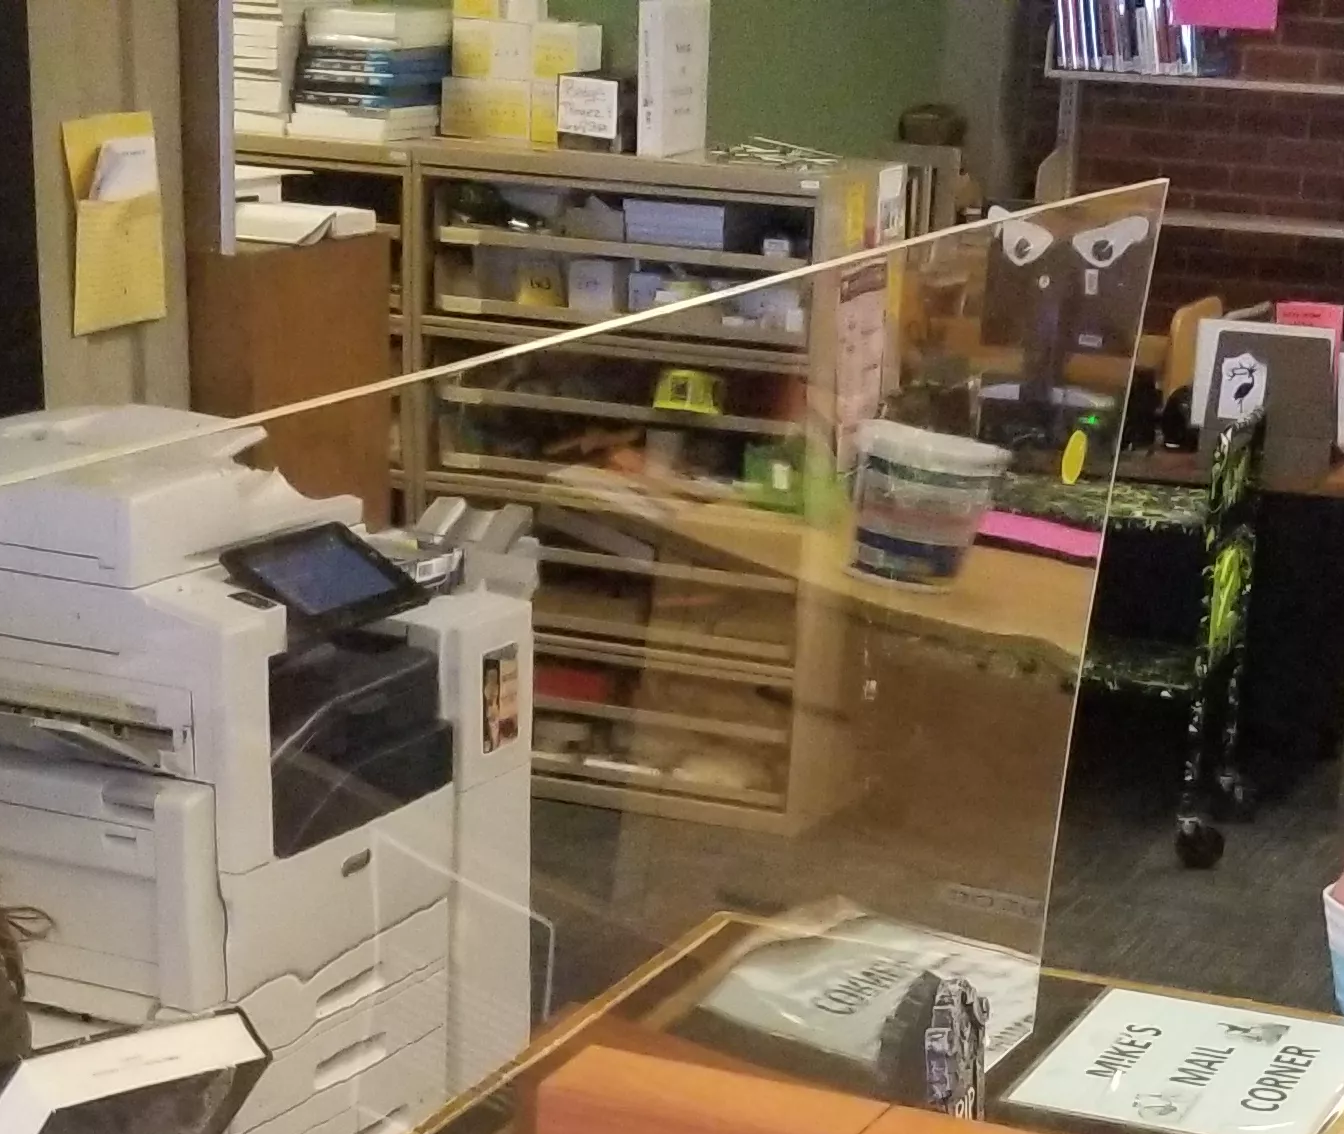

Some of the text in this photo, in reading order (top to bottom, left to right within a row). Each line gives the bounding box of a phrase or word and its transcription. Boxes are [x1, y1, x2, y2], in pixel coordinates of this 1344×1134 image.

[1085, 1024, 1163, 1078] MIKE'S
[1168, 1046, 1236, 1087] MAIL
[1240, 1045, 1322, 1112] CORNER
